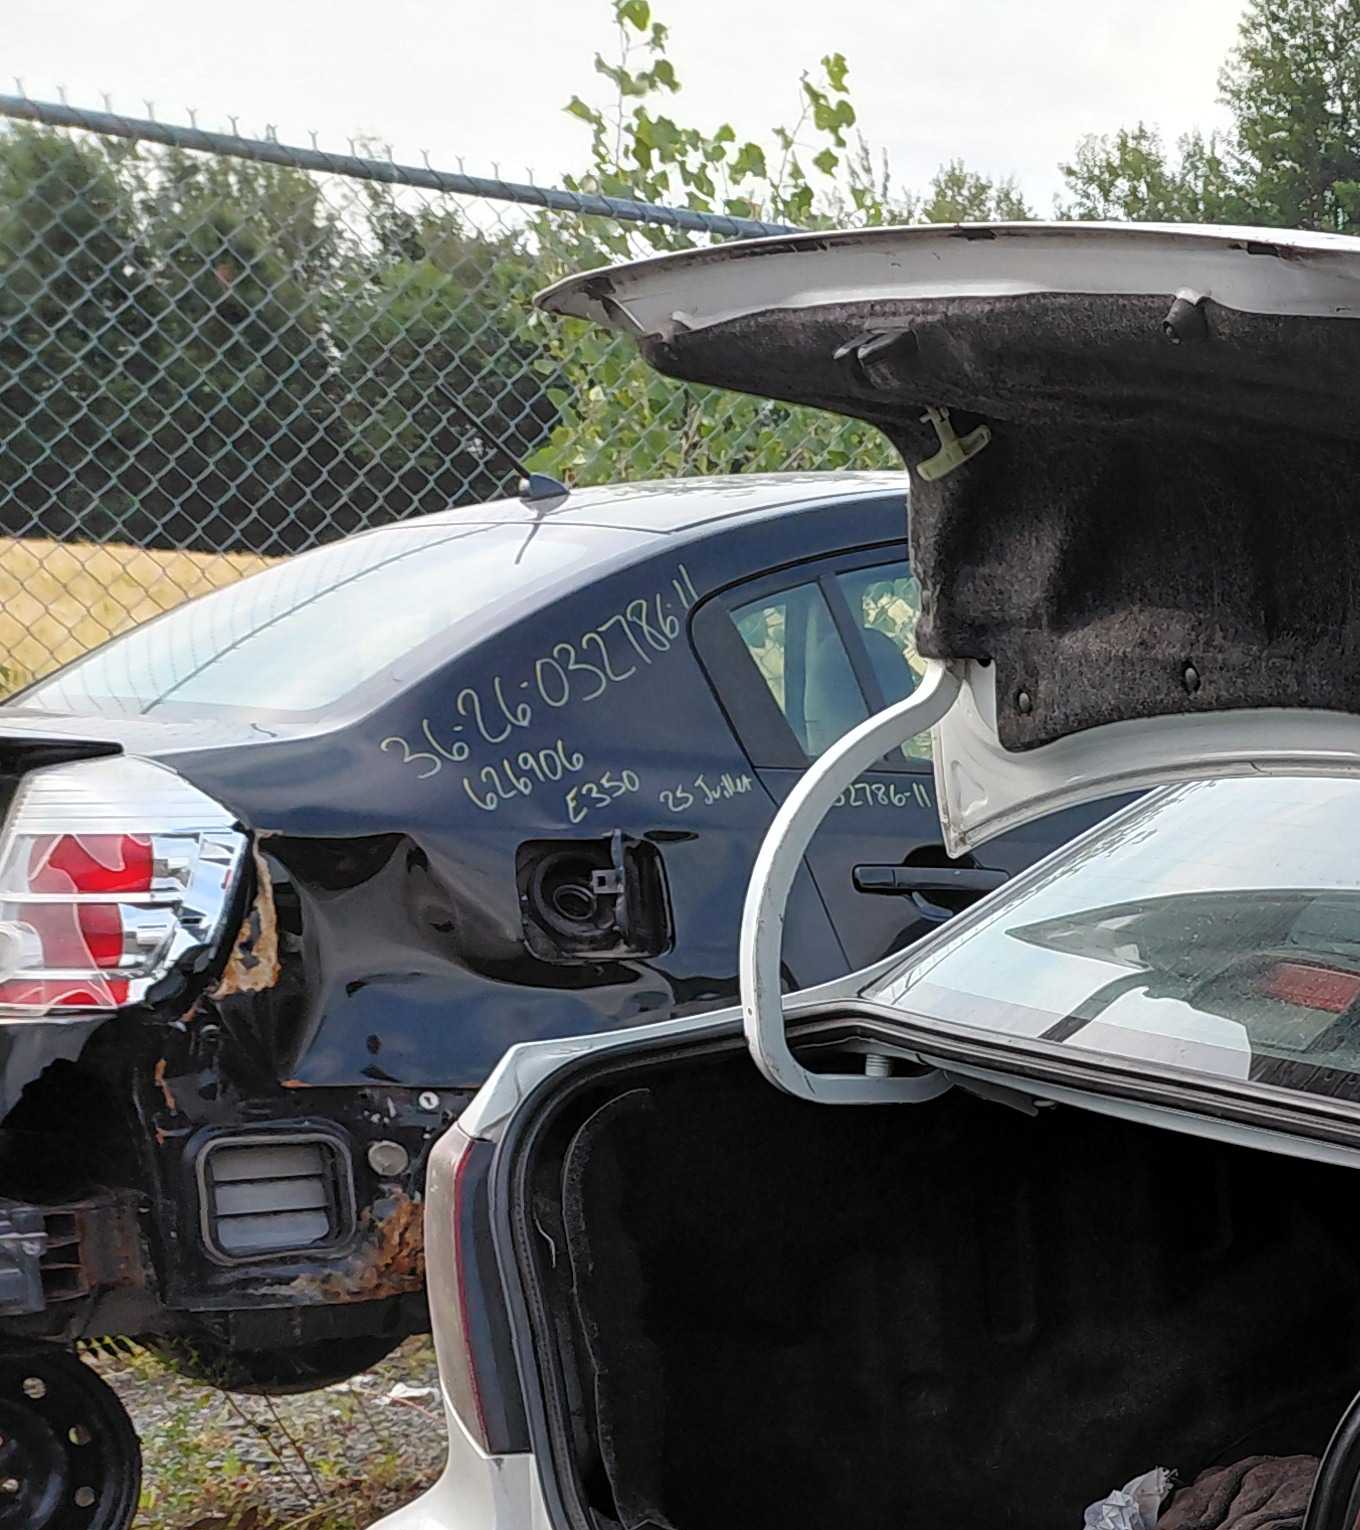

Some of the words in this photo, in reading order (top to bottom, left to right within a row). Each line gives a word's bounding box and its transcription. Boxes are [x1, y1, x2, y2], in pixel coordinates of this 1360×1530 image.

[463, 738, 584, 811] 626906
[566, 769, 640, 824] E350
[659, 783, 694, 812] 25
